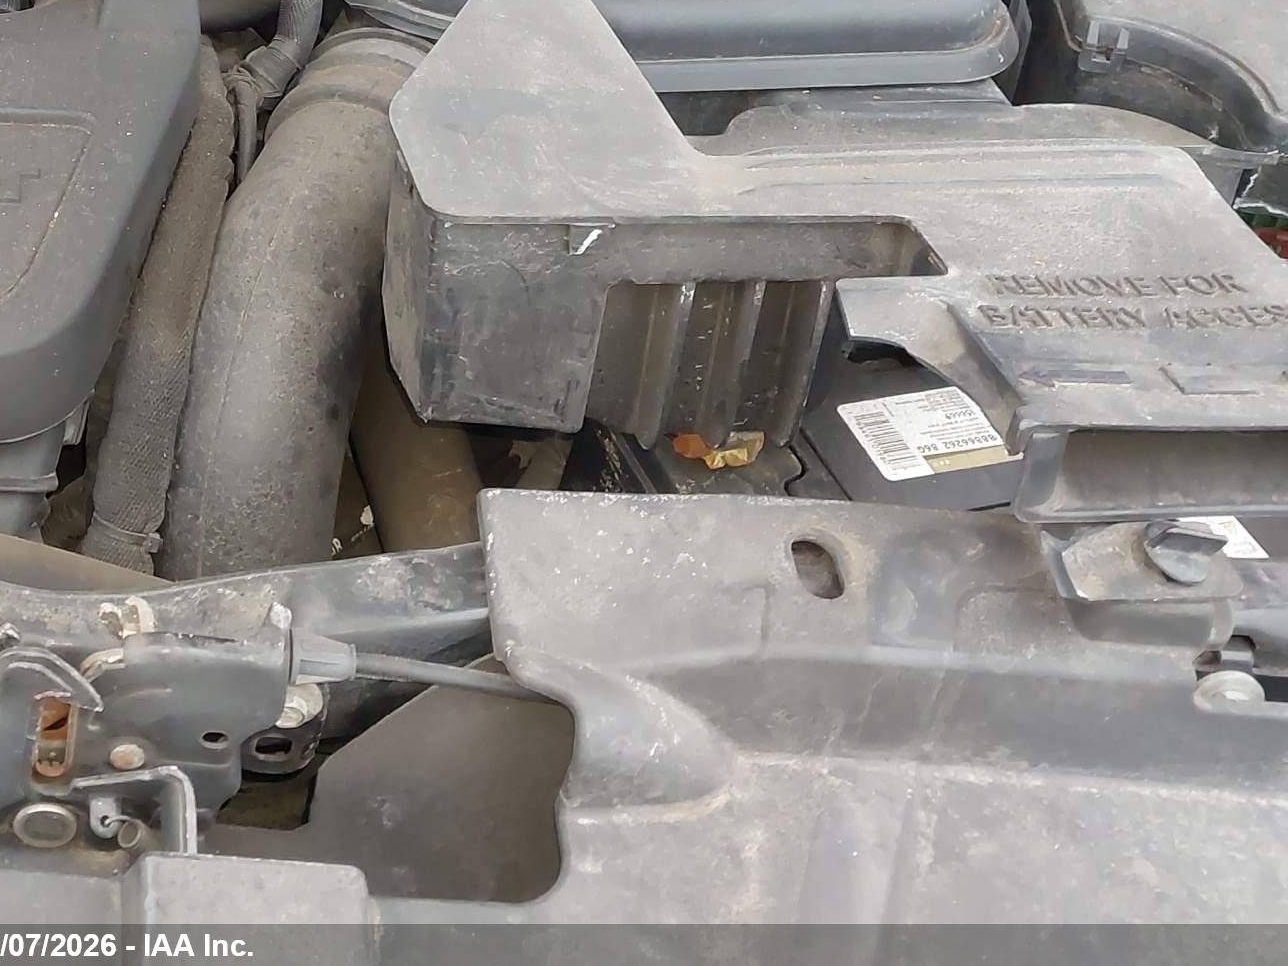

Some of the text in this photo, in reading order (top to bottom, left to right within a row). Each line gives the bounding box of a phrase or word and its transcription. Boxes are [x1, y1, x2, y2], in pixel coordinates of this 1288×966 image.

[985, 273, 1249, 297] REMOVE FOR
[977, 304, 1146, 329] BATTERY
